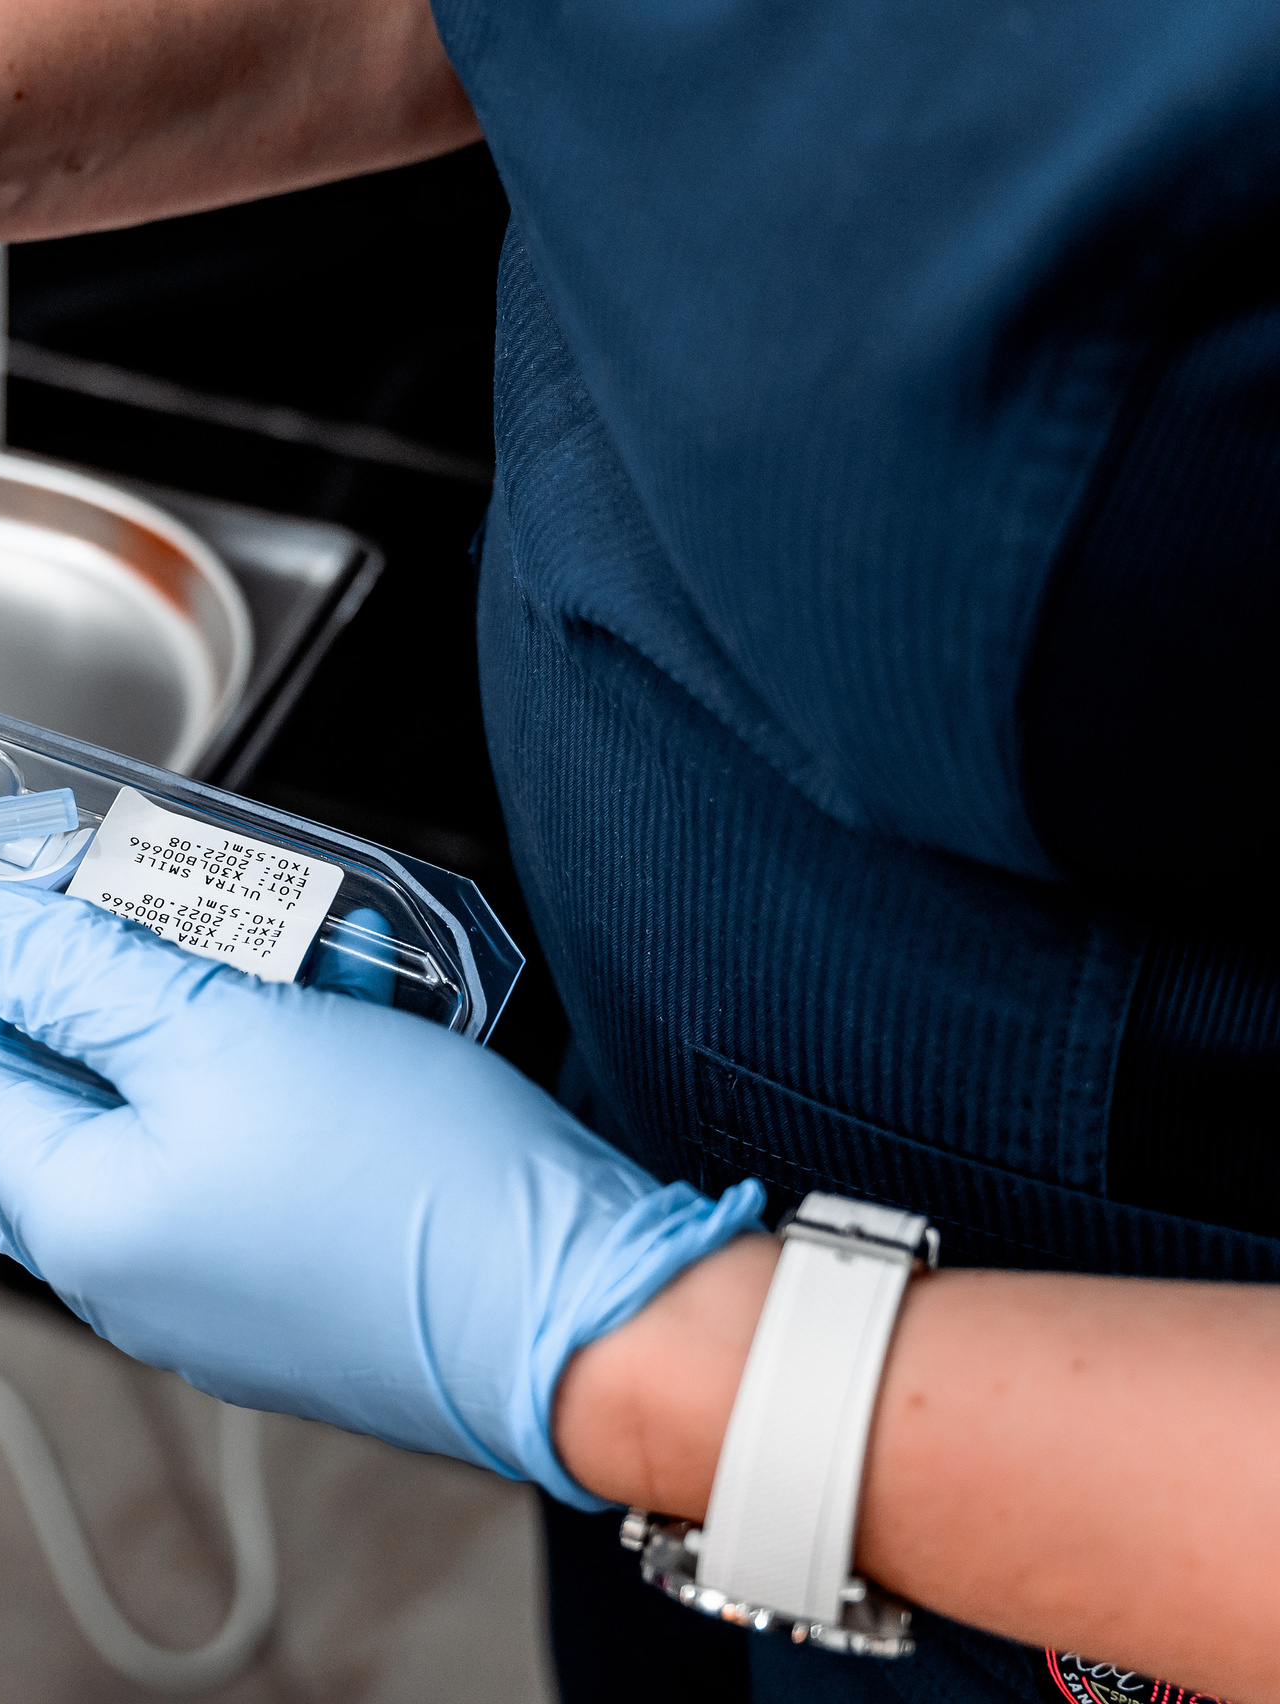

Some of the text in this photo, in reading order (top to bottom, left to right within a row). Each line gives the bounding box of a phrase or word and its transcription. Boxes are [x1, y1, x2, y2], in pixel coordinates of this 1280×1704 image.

[129, 836, 303, 900] LOT: X30LB00666
[133, 853, 192, 879] SMILE
[168, 837, 308, 888] EXP: 2022.08
[223, 840, 311, 877] 1x0.55ml
[204, 875, 261, 902] ULTRA
[100, 892, 218, 938] X30LB00666
[141, 893, 225, 928] 2022.08
[196, 895, 286, 930] 1x0.55ml
[177, 932, 235, 954] ULTRA
[231, 933, 277, 949] LOT:
[237, 923, 283, 939] EXP:
